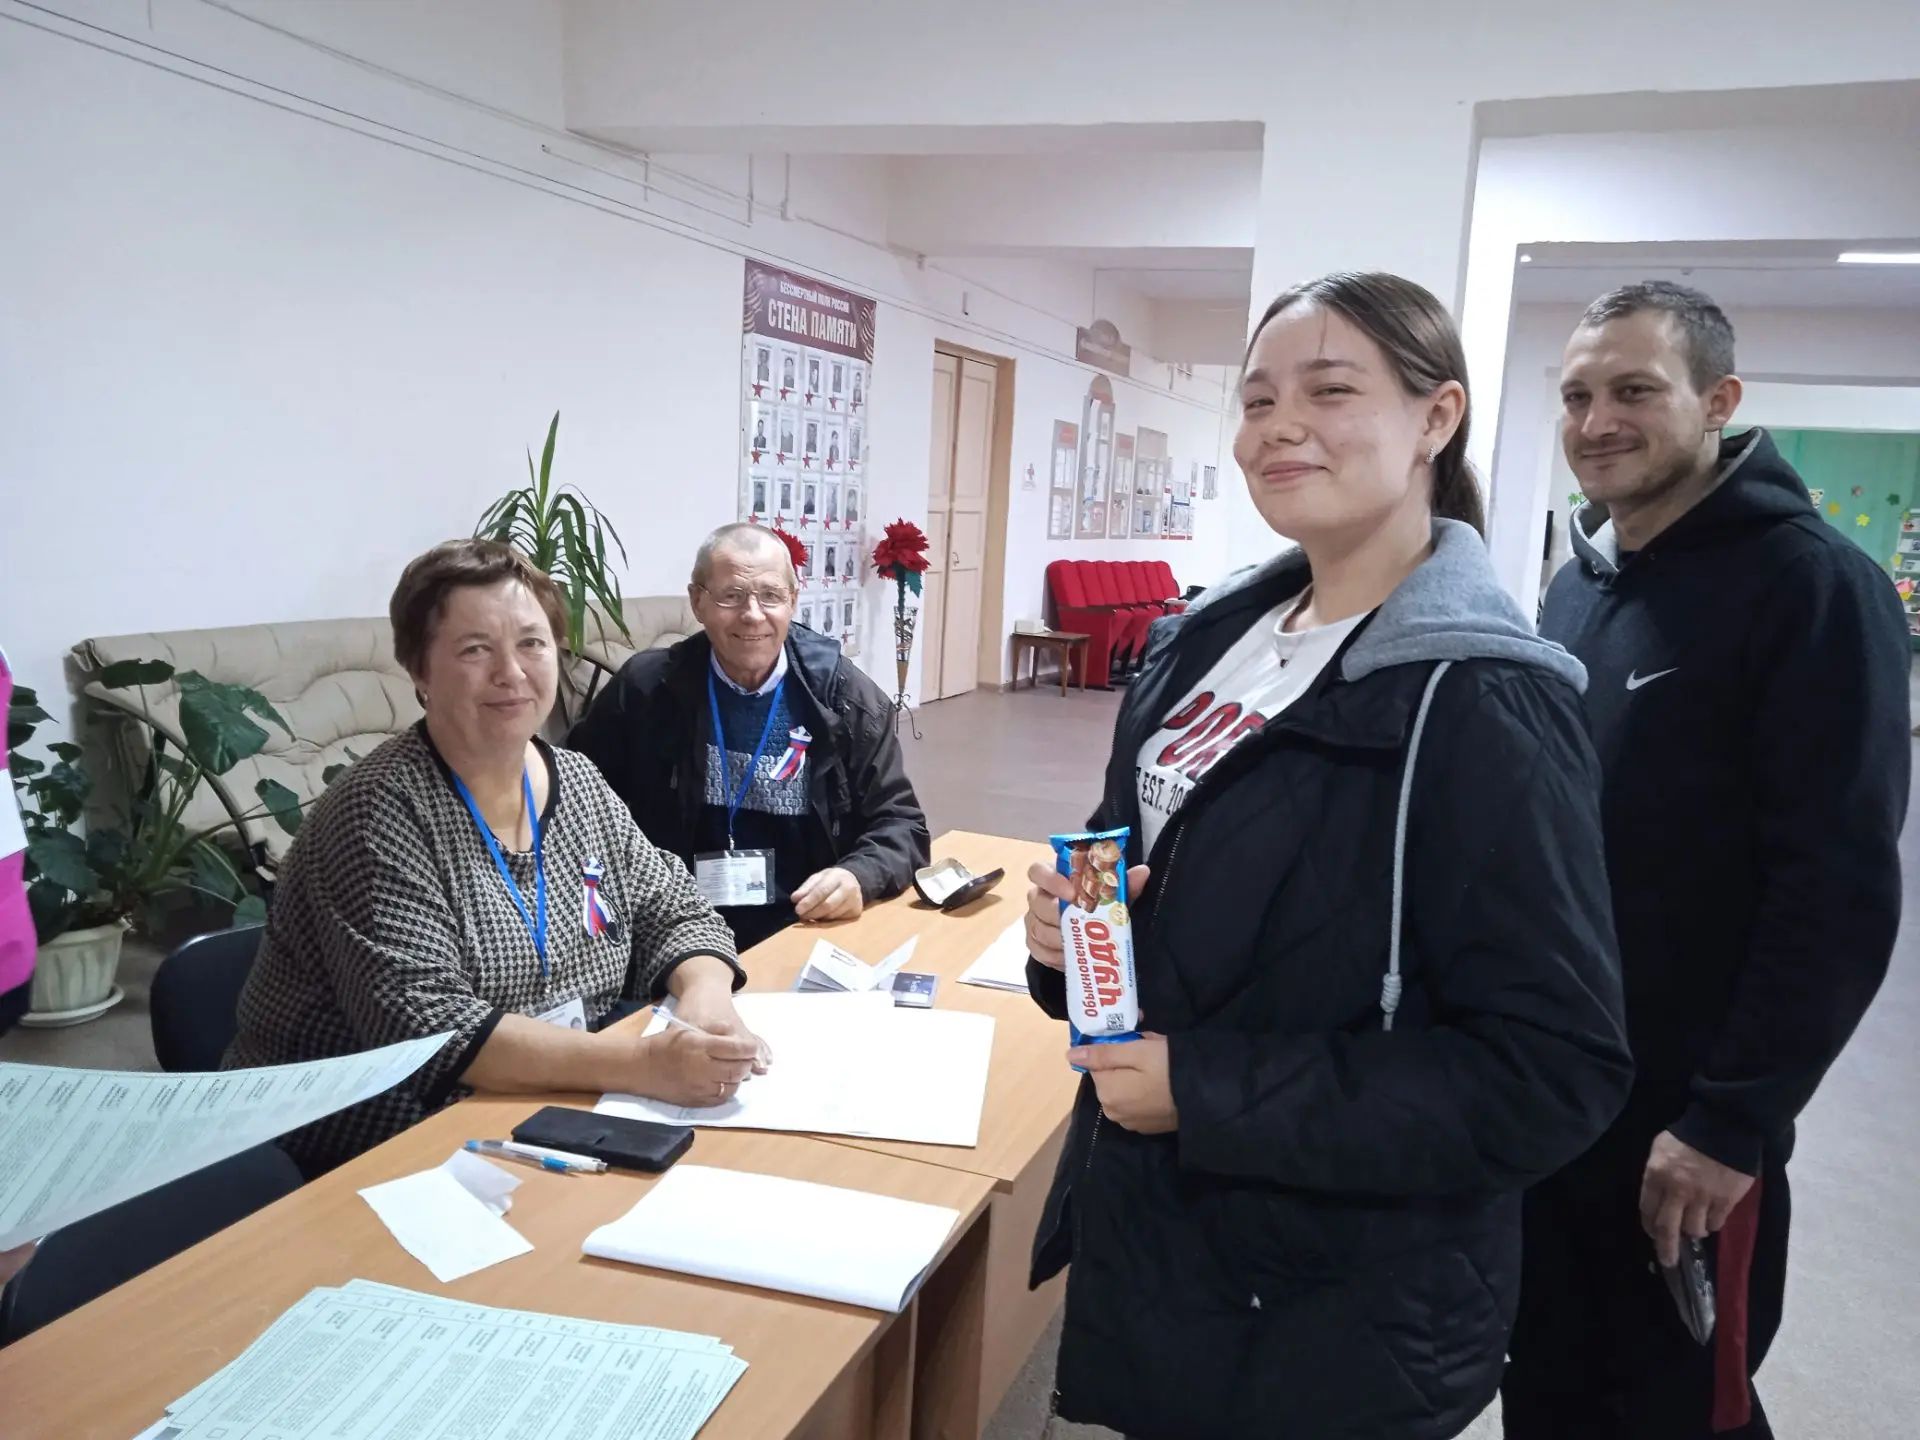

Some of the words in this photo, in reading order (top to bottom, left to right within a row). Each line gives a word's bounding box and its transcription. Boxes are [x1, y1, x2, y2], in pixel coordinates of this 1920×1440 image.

[768, 298, 808, 336] СТЕНА
[810, 311, 857, 349] ПАМЯТИ
[1141, 771, 1163, 810] EST.
[1069, 917, 1099, 1018] Обыкновенное
[1084, 920, 1123, 1008] ЧУДО
